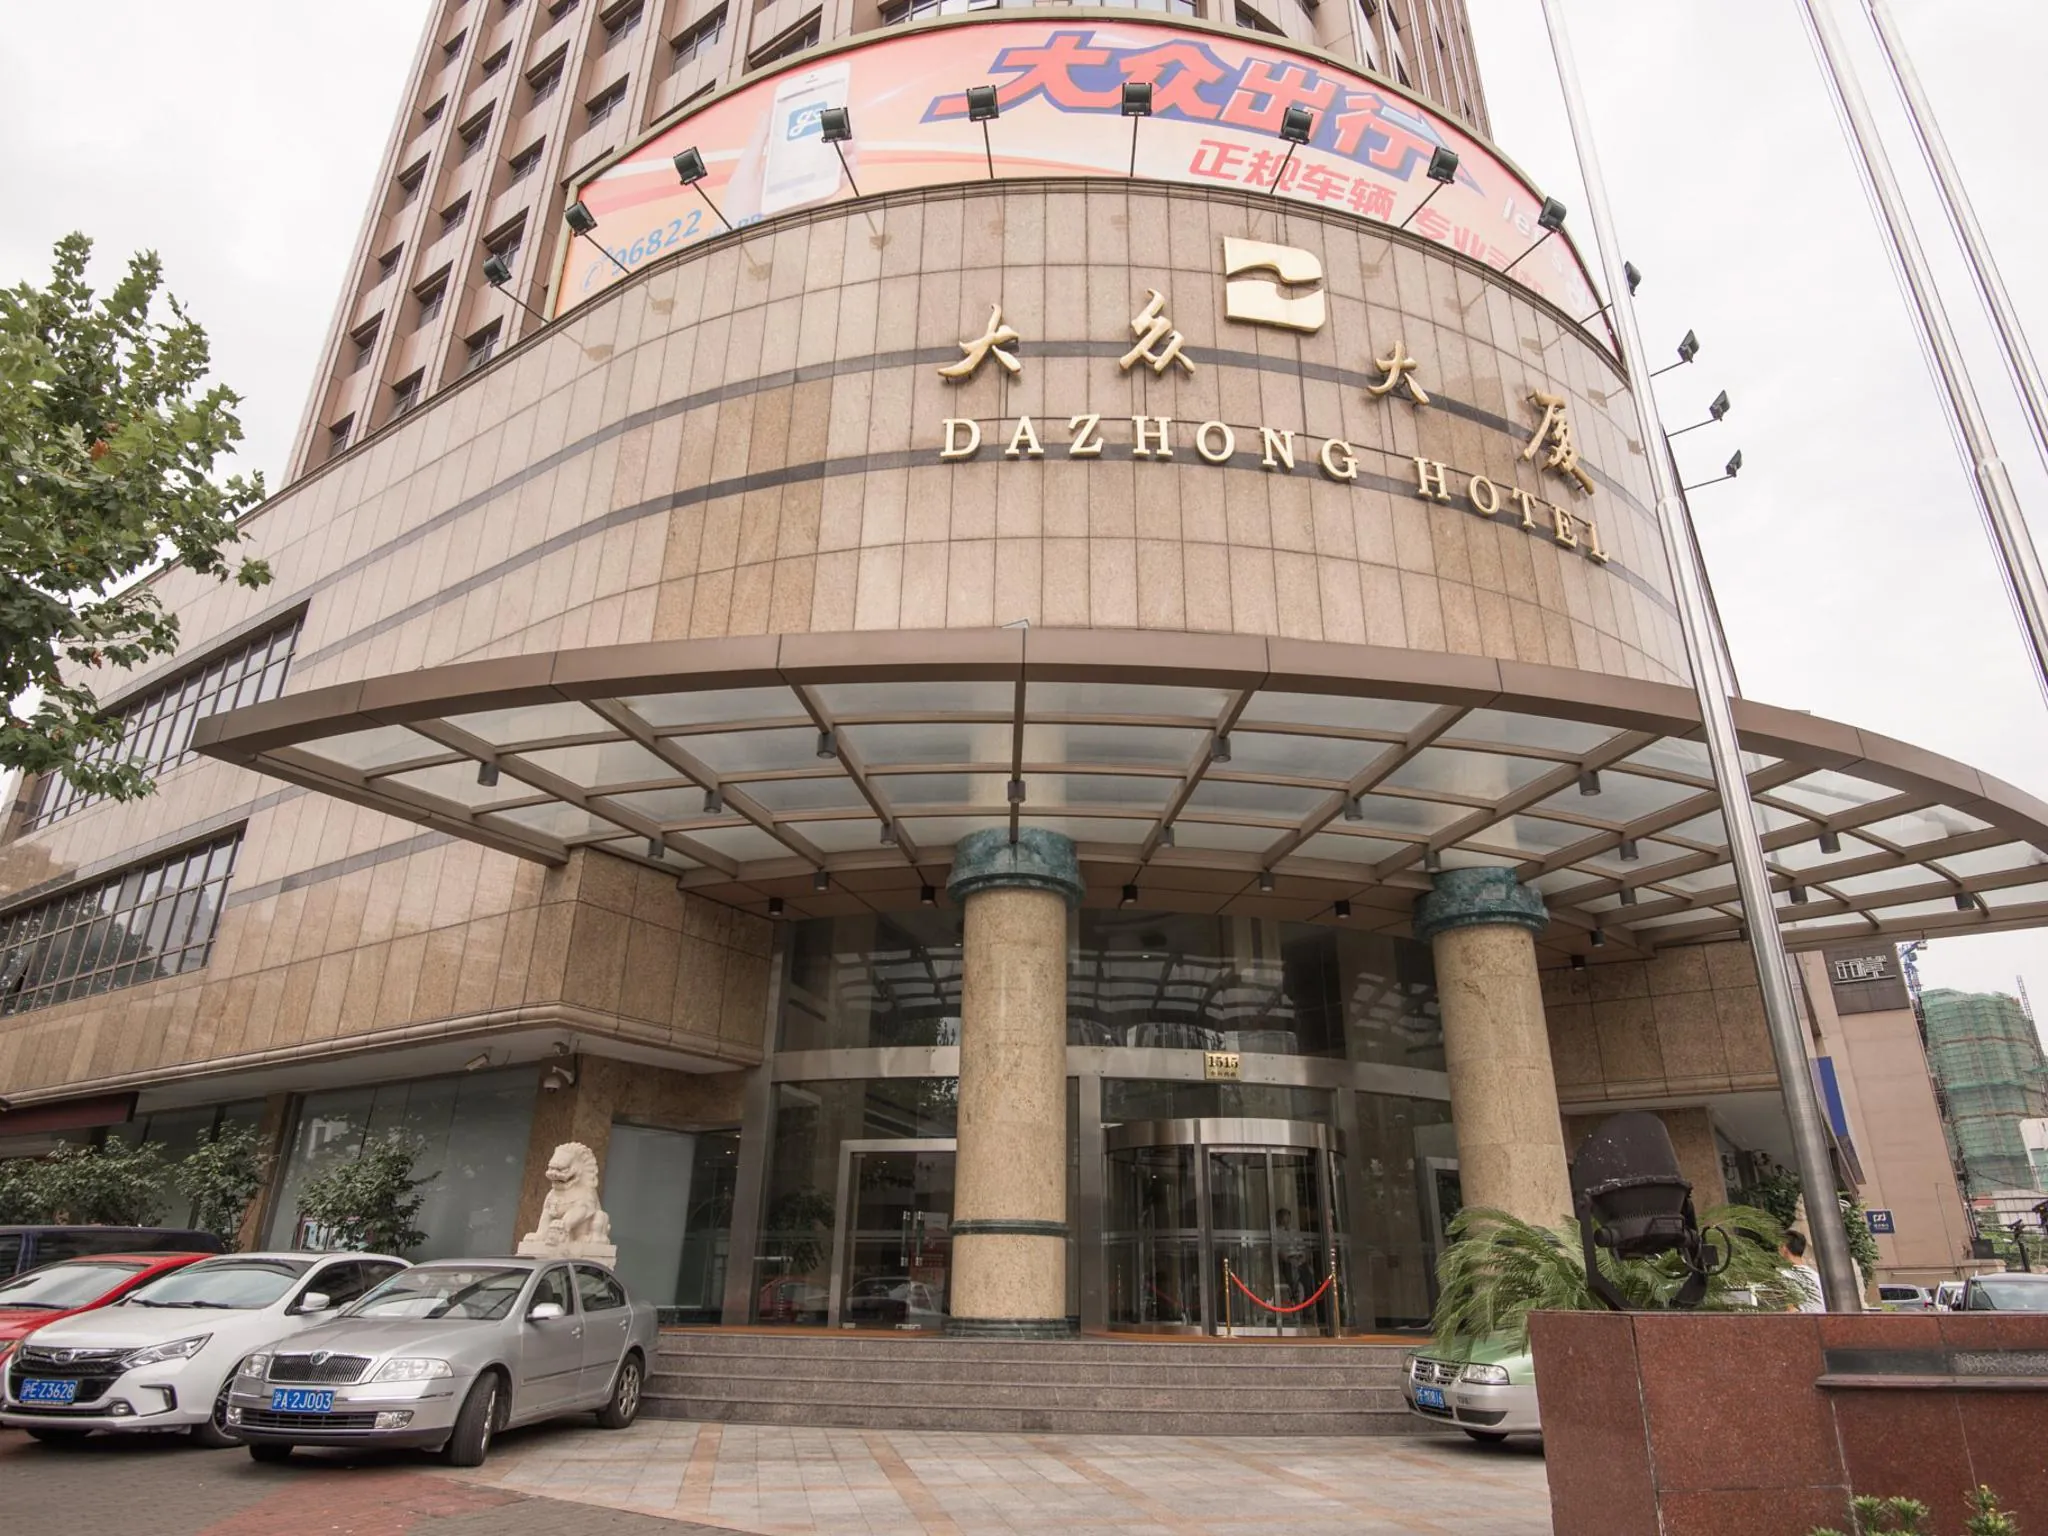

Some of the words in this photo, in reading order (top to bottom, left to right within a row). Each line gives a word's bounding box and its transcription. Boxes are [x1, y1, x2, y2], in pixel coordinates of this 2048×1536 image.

[925, 32, 1434, 180] 大众出行
[1188, 138, 1398, 222] 正规车辆
[611, 208, 703, 277] 96822
[940, 413, 1359, 480] DAZHONG
[1412, 456, 1610, 562] HOTEL
[1208, 1055, 1239, 1069] 1515
